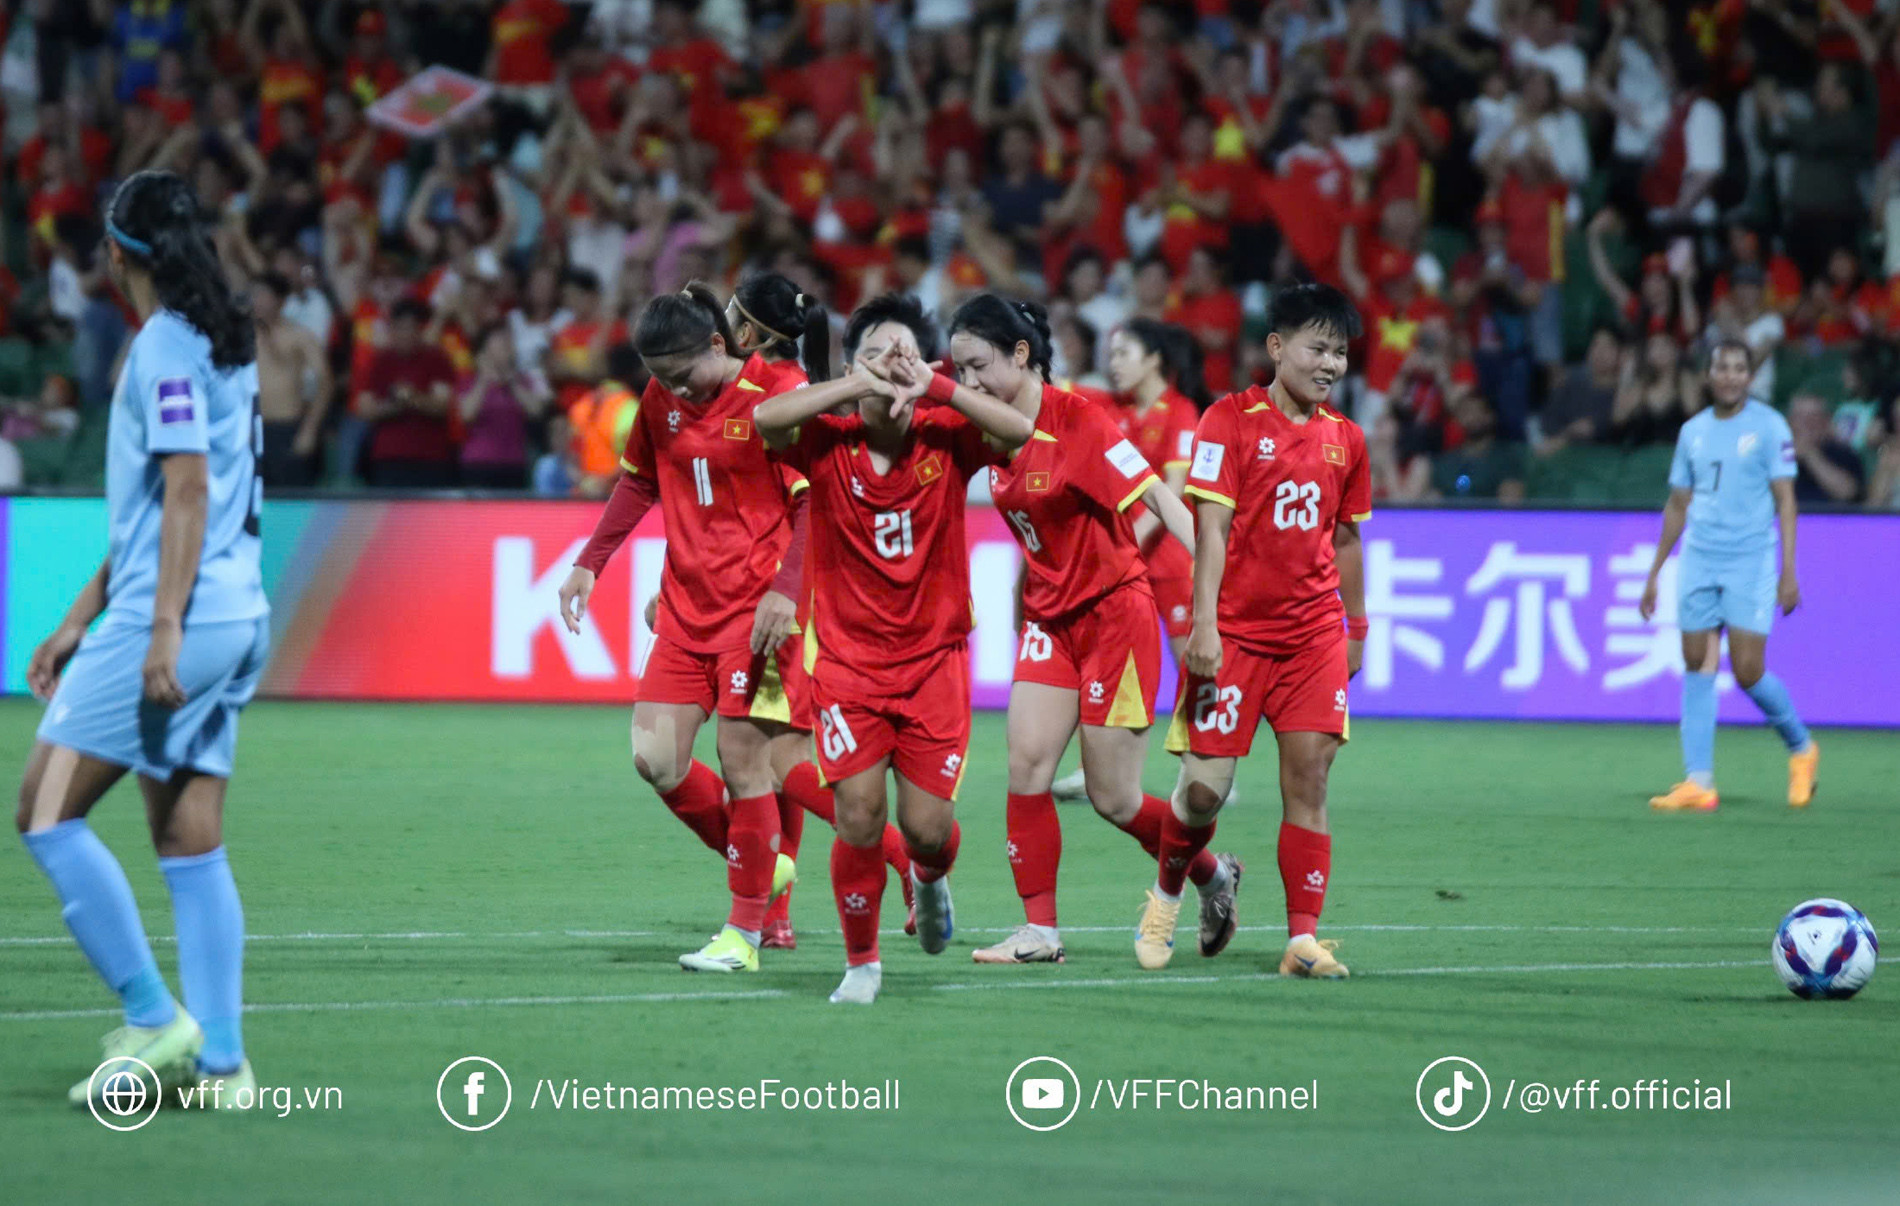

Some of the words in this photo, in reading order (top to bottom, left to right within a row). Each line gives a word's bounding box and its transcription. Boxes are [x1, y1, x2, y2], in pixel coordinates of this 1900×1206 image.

[692, 456, 714, 507] 11
[1711, 460, 1722, 492] 7
[1273, 480, 1321, 532] 23
[874, 509, 914, 559] 21
[820, 703, 858, 762] 21
[1194, 682, 1242, 735] 23
